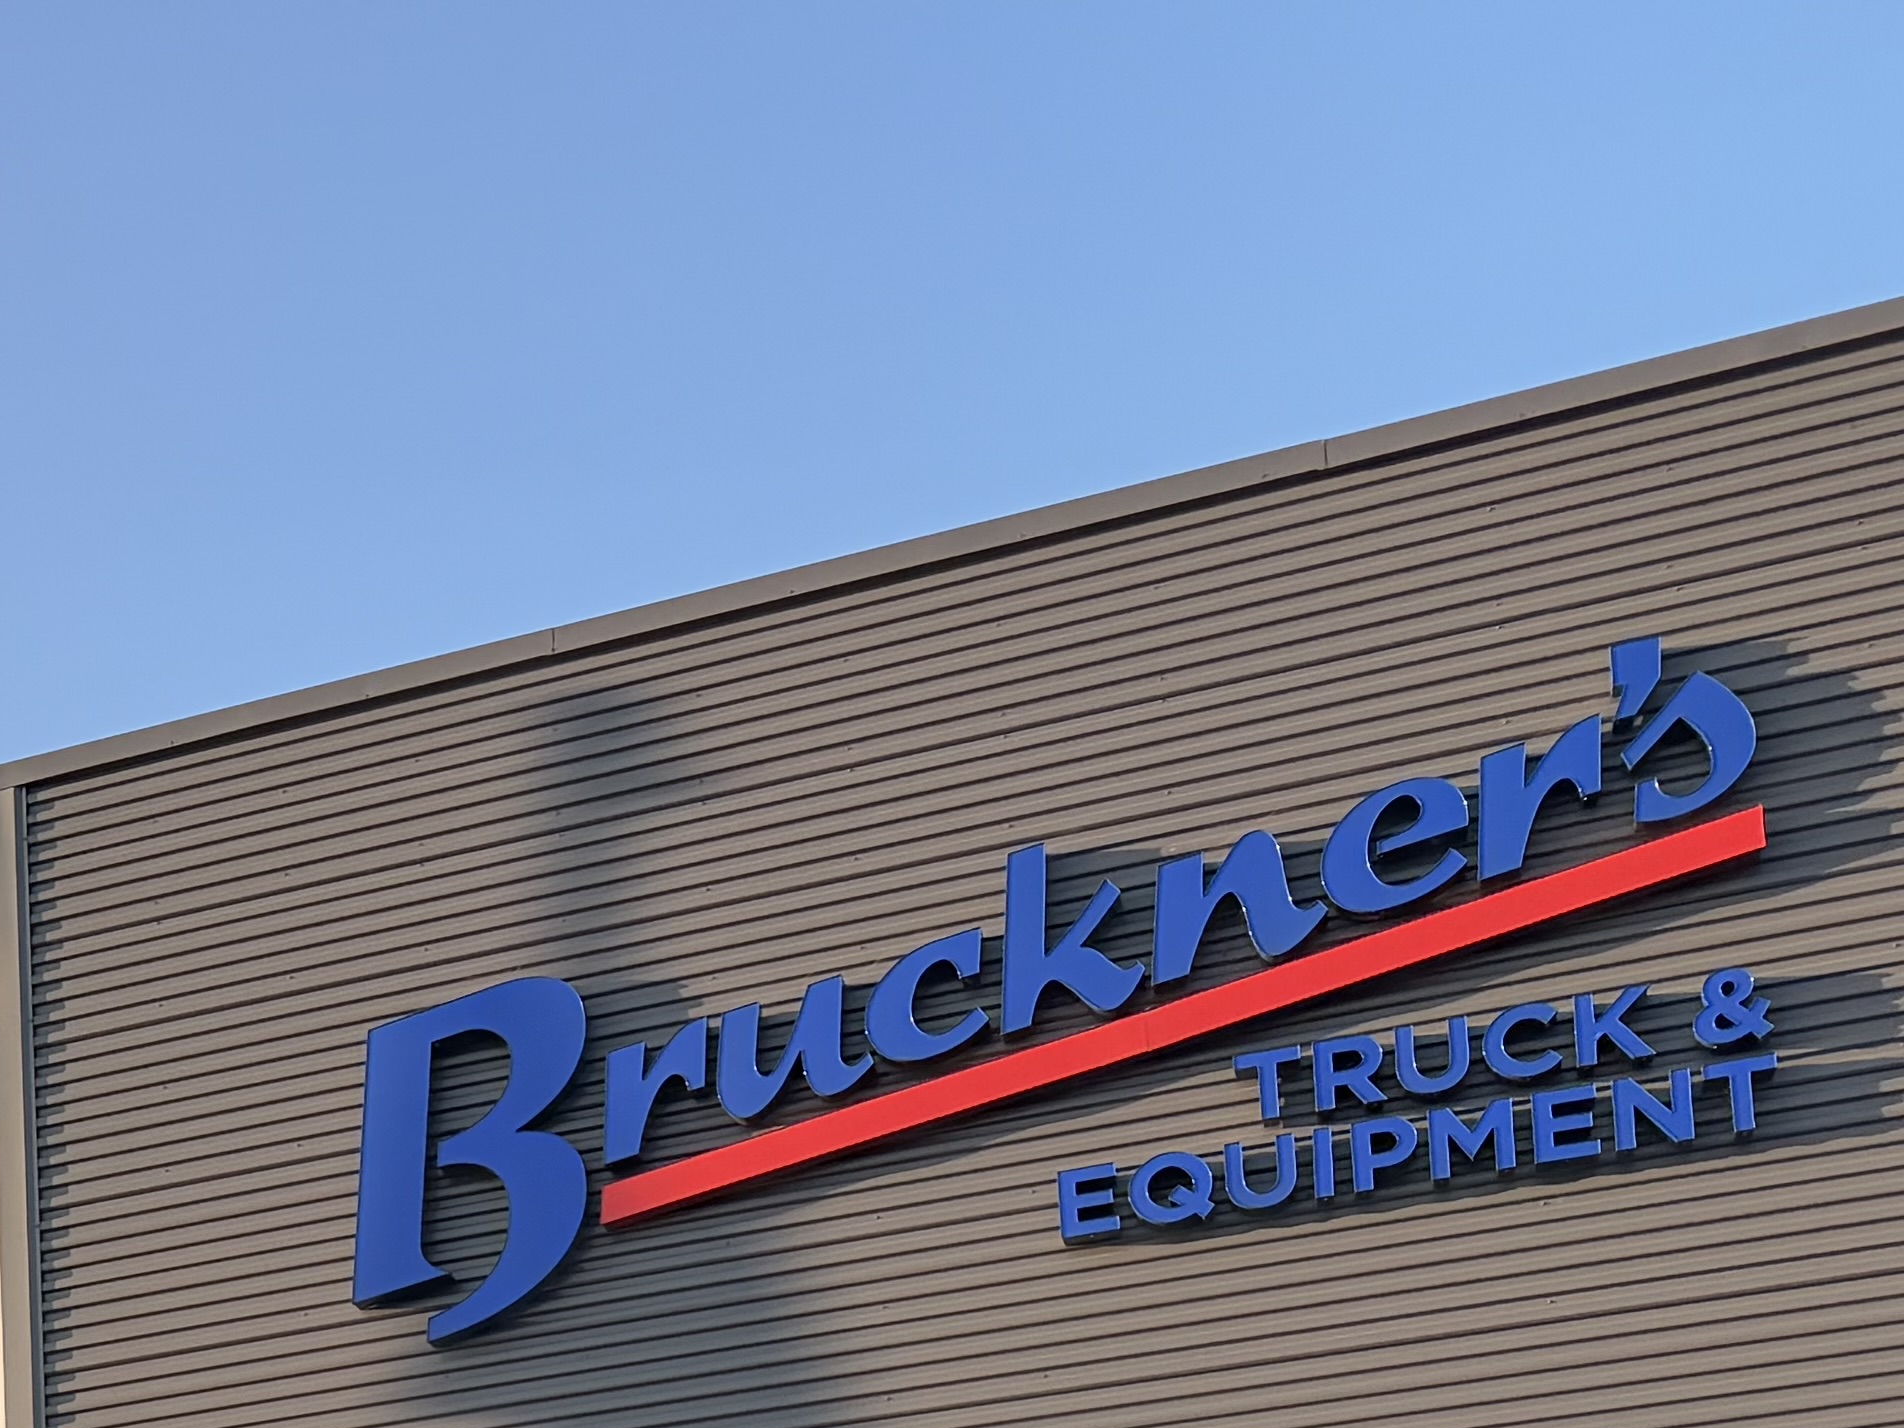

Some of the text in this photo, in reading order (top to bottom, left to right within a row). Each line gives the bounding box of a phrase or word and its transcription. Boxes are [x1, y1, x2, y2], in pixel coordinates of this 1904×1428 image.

[352, 635, 1757, 1347] Bruckner's
[1233, 967, 1778, 1126] TRUCK &
[1056, 1051, 1780, 1246] EQUIPMENT
